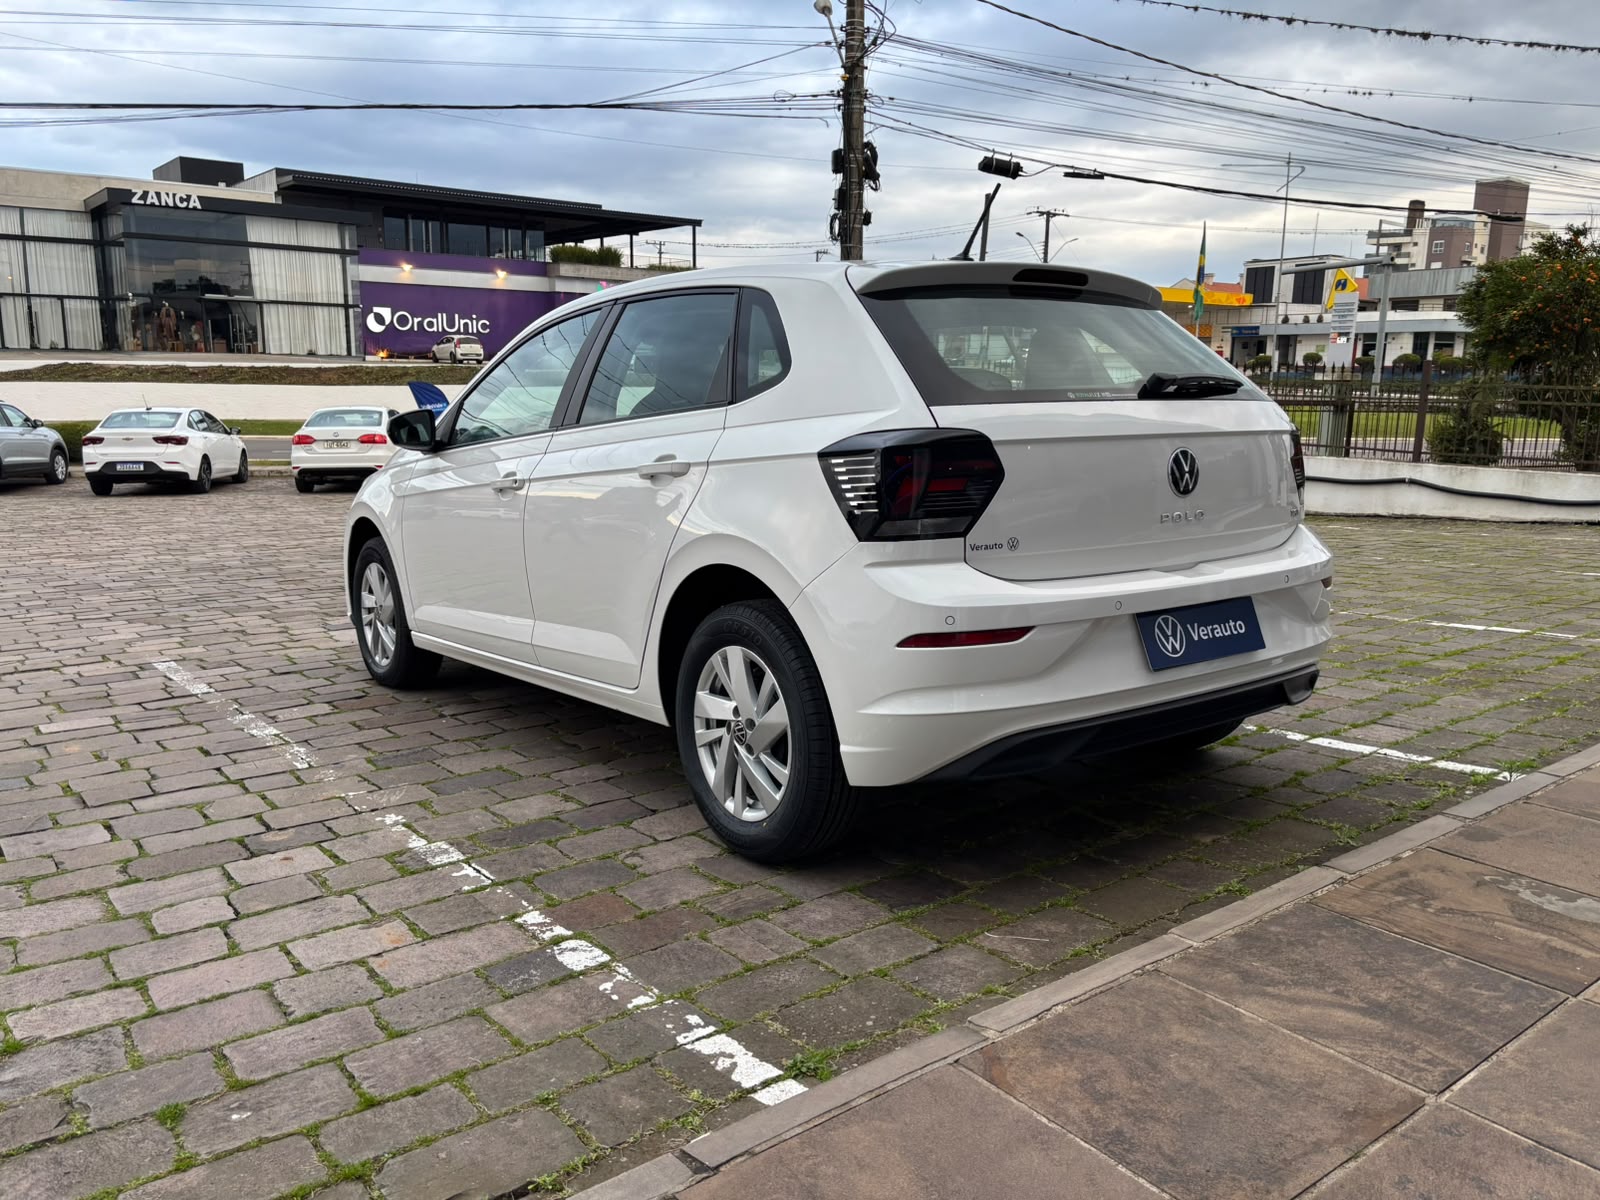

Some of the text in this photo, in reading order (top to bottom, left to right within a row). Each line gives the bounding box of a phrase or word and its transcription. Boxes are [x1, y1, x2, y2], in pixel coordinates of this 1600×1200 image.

[131, 189, 202, 209] ZANCA
[393, 311, 490, 334] OralUnic
[1160, 510, 1205, 525] POLO
[969, 542, 1003, 552] Verauto
[1187, 619, 1246, 641] Verauto
